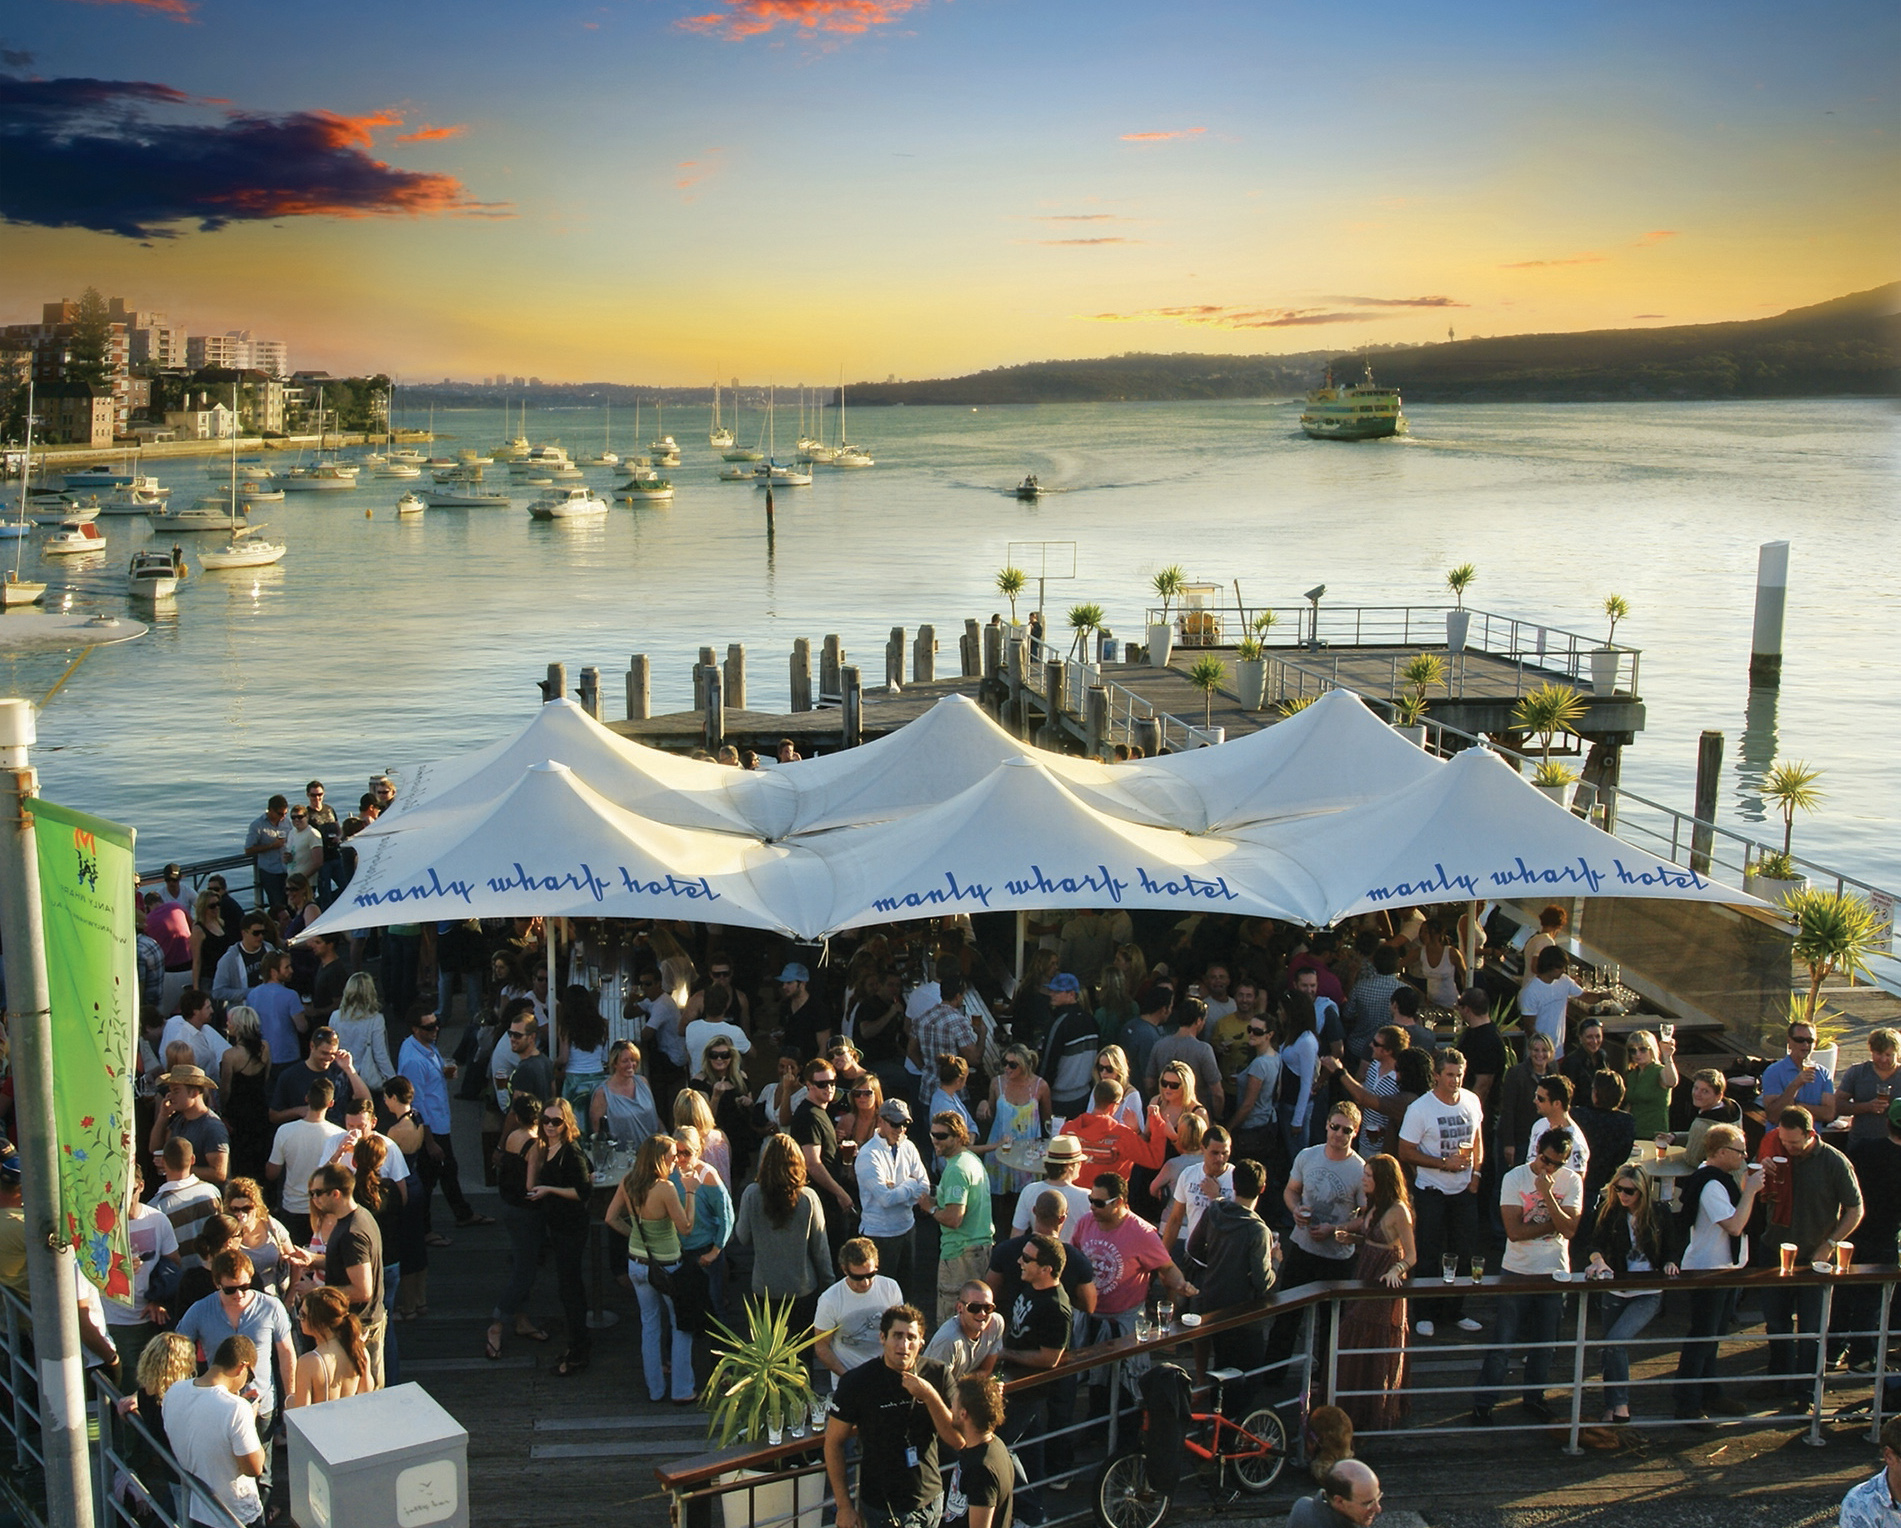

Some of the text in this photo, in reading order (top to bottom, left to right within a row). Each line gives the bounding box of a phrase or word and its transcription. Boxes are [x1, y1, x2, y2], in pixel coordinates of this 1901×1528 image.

[353, 862, 721, 908] manly wharf hotel
[872, 865, 1239, 912] manly wharf hotel
[1366, 858, 1710, 901] manly wharf hotel
